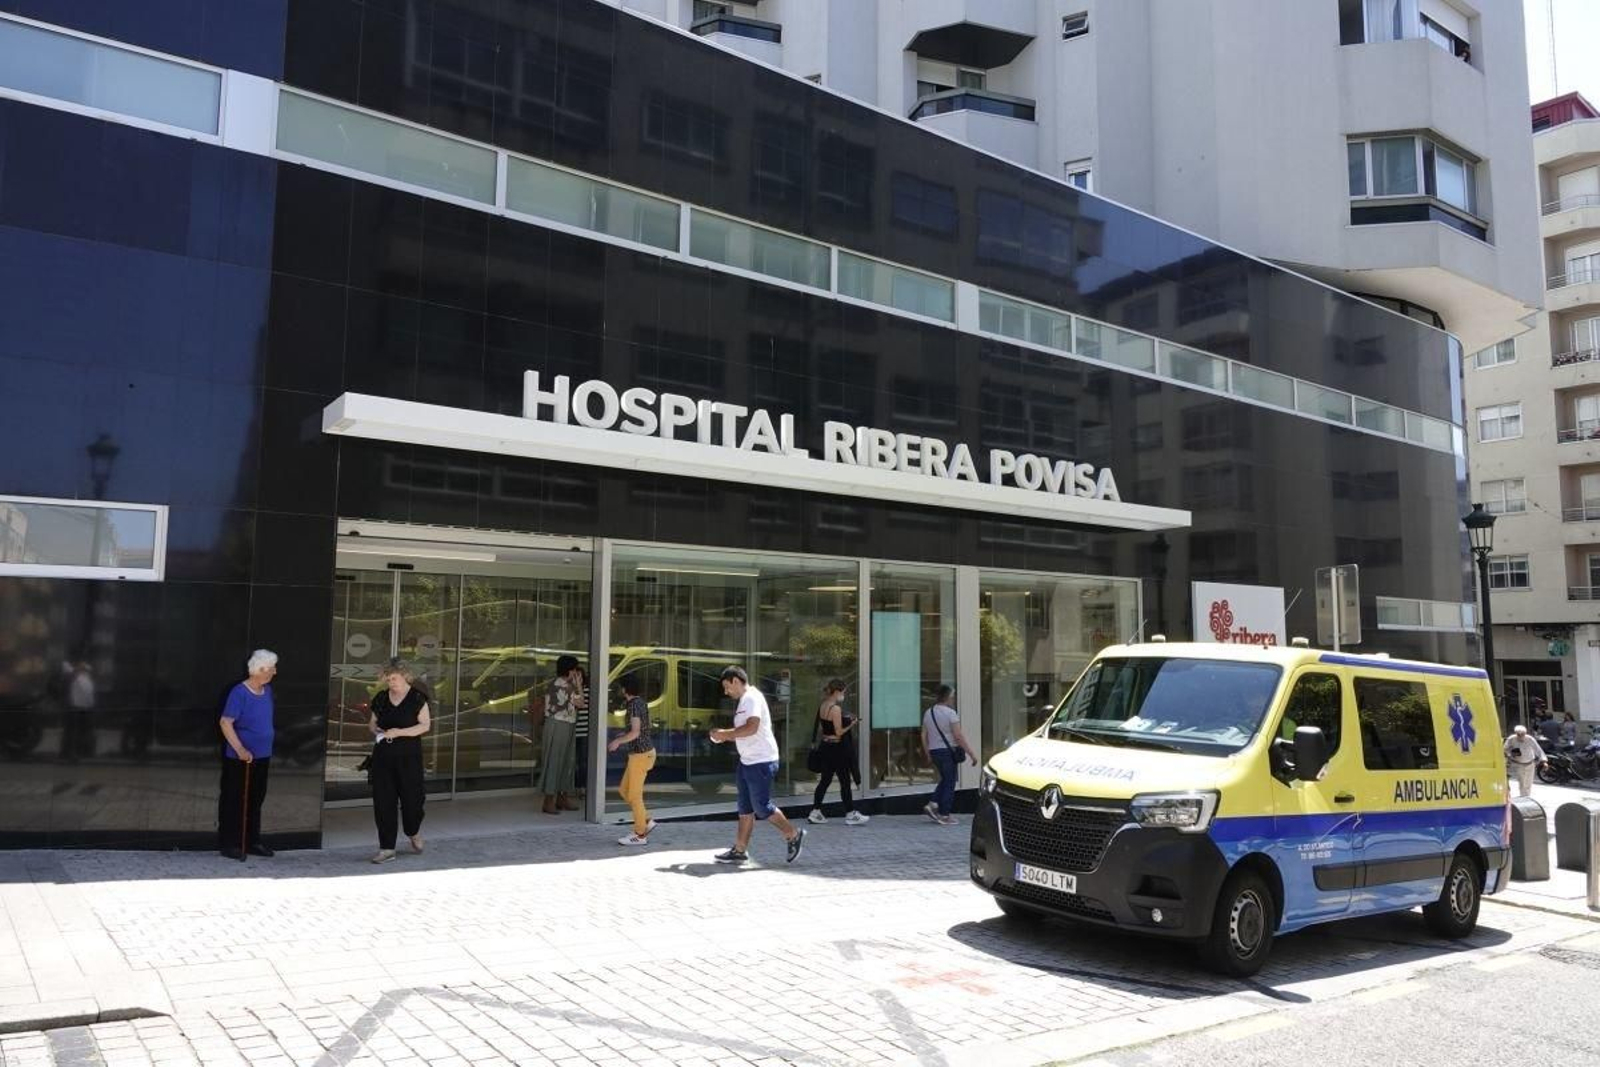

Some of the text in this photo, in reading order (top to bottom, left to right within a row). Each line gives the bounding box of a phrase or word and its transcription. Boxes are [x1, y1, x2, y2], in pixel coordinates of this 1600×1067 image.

[522, 370, 1121, 502] HOSPITAL RIBERA POVISA
[1231, 626, 1277, 646] ribera
[1394, 778, 1479, 803] AMBULANCIA
[1022, 866, 1074, 891] 5040 LTM
